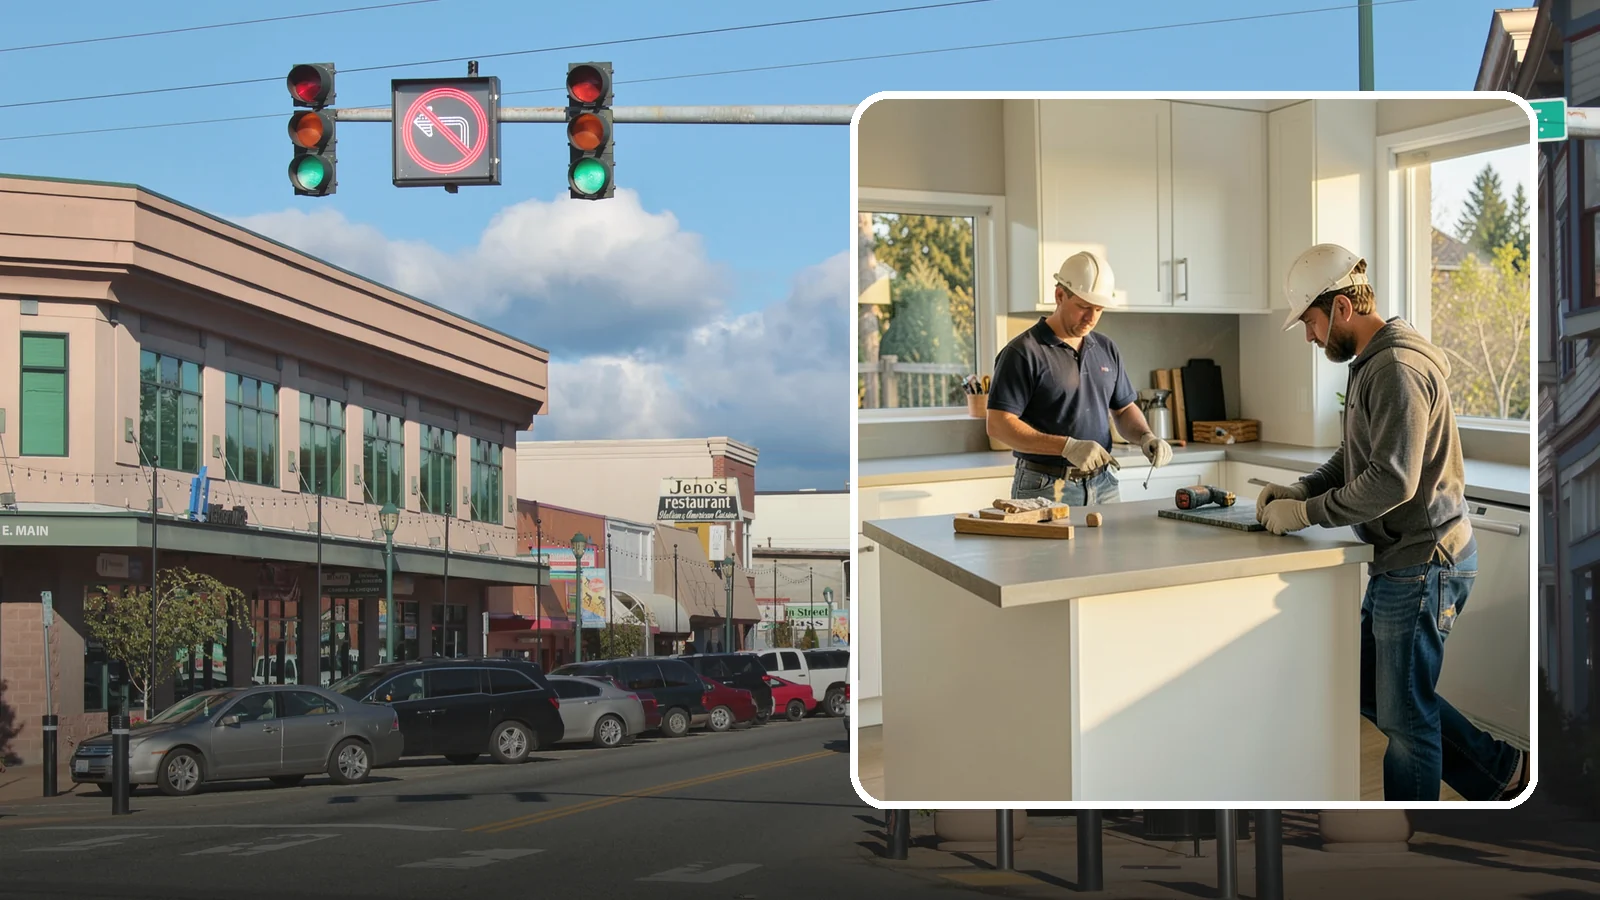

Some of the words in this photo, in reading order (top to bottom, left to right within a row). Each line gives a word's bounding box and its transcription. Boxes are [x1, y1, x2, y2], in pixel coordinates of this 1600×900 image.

[669, 480, 728, 495] Jeno's
[665, 496, 731, 509] restaurant
[658, 509, 681, 519] Italian
[685, 509, 715, 520] American
[715, 508, 738, 519] Cuisine
[2, 525, 13, 536] E.
[15, 525, 49, 537] MAIN
[797, 607, 829, 617] Street
